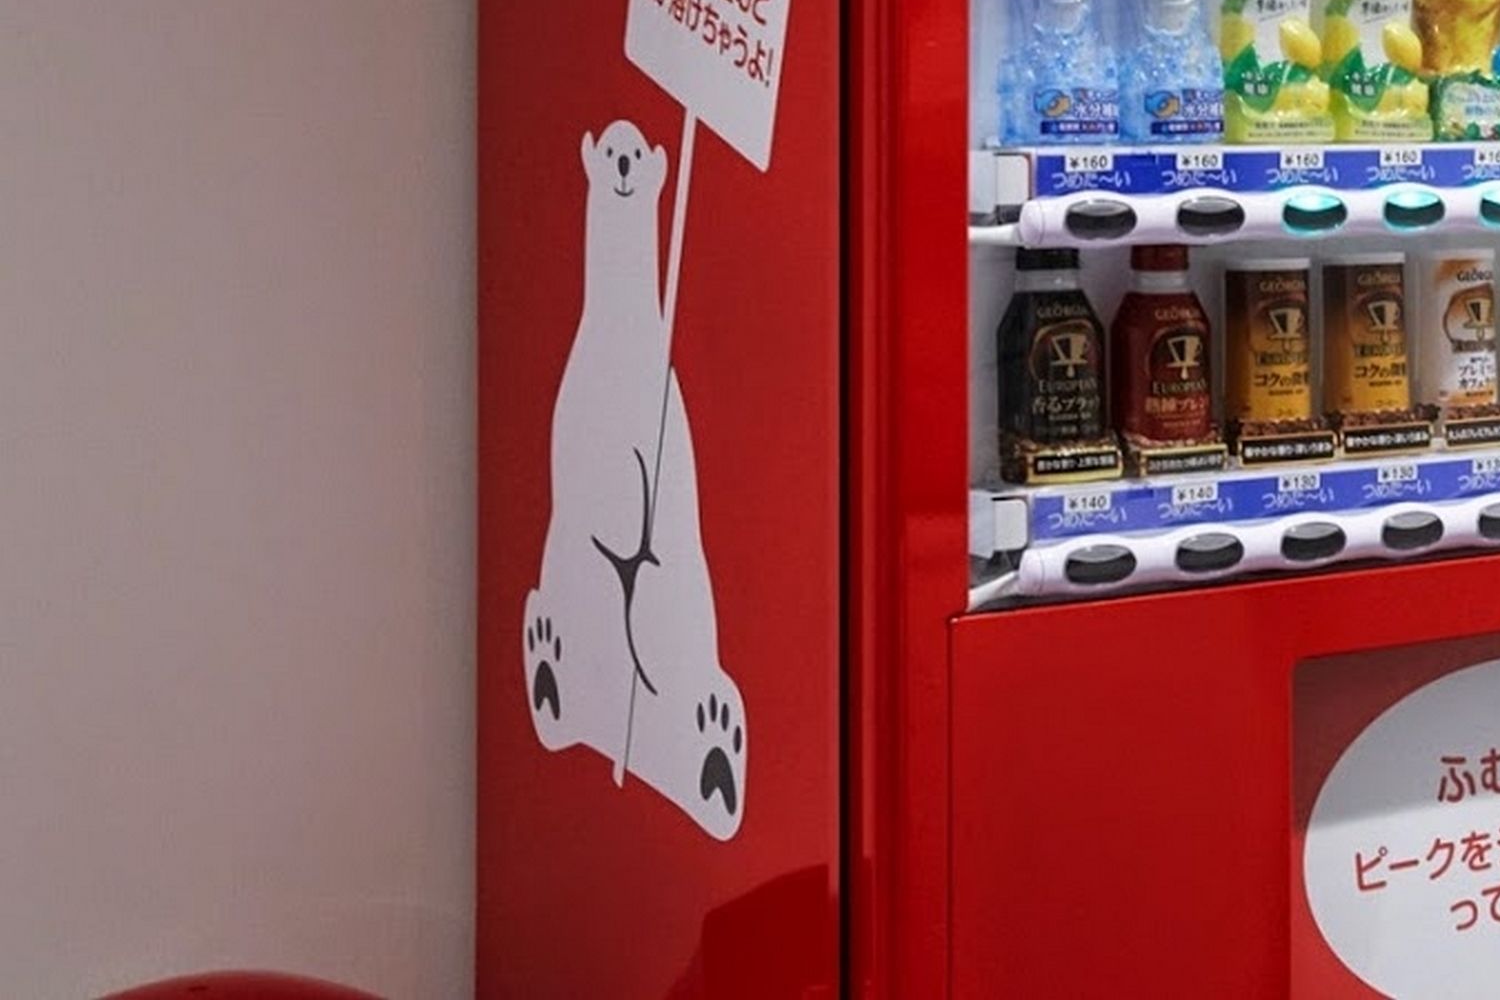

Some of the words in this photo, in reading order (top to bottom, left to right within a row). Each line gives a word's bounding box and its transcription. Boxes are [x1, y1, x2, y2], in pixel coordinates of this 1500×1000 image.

[1069, 155, 1108, 168] ¥160
[1181, 154, 1218, 167] ¥160
[1286, 153, 1318, 167] ¥160
[1384, 151, 1417, 163] ¥160
[1176, 486, 1214, 501] ¥140
[1068, 495, 1106, 510] ¥140
